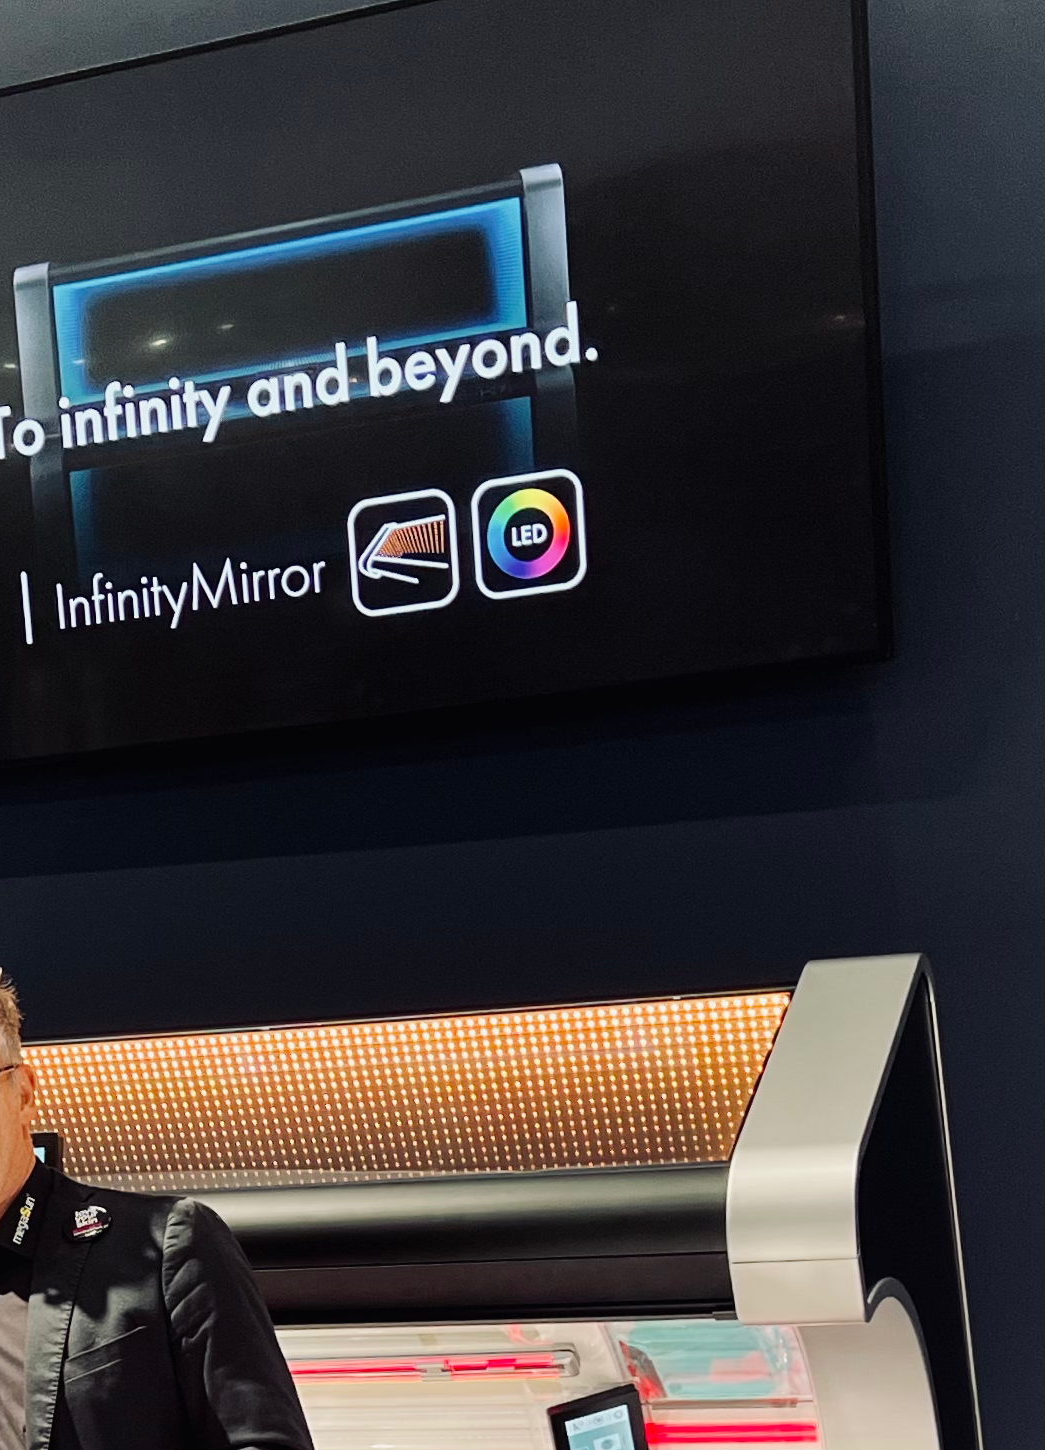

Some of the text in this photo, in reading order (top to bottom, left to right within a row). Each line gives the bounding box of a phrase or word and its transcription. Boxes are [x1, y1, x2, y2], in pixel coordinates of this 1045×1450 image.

[58, 376, 232, 449] infinity
[247, 341, 350, 417] and
[366, 300, 599, 403] beyond.
[511, 523, 548, 547] LED
[56, 557, 326, 629] InfinityMirror
[12, 1196, 36, 1245] megaSun
